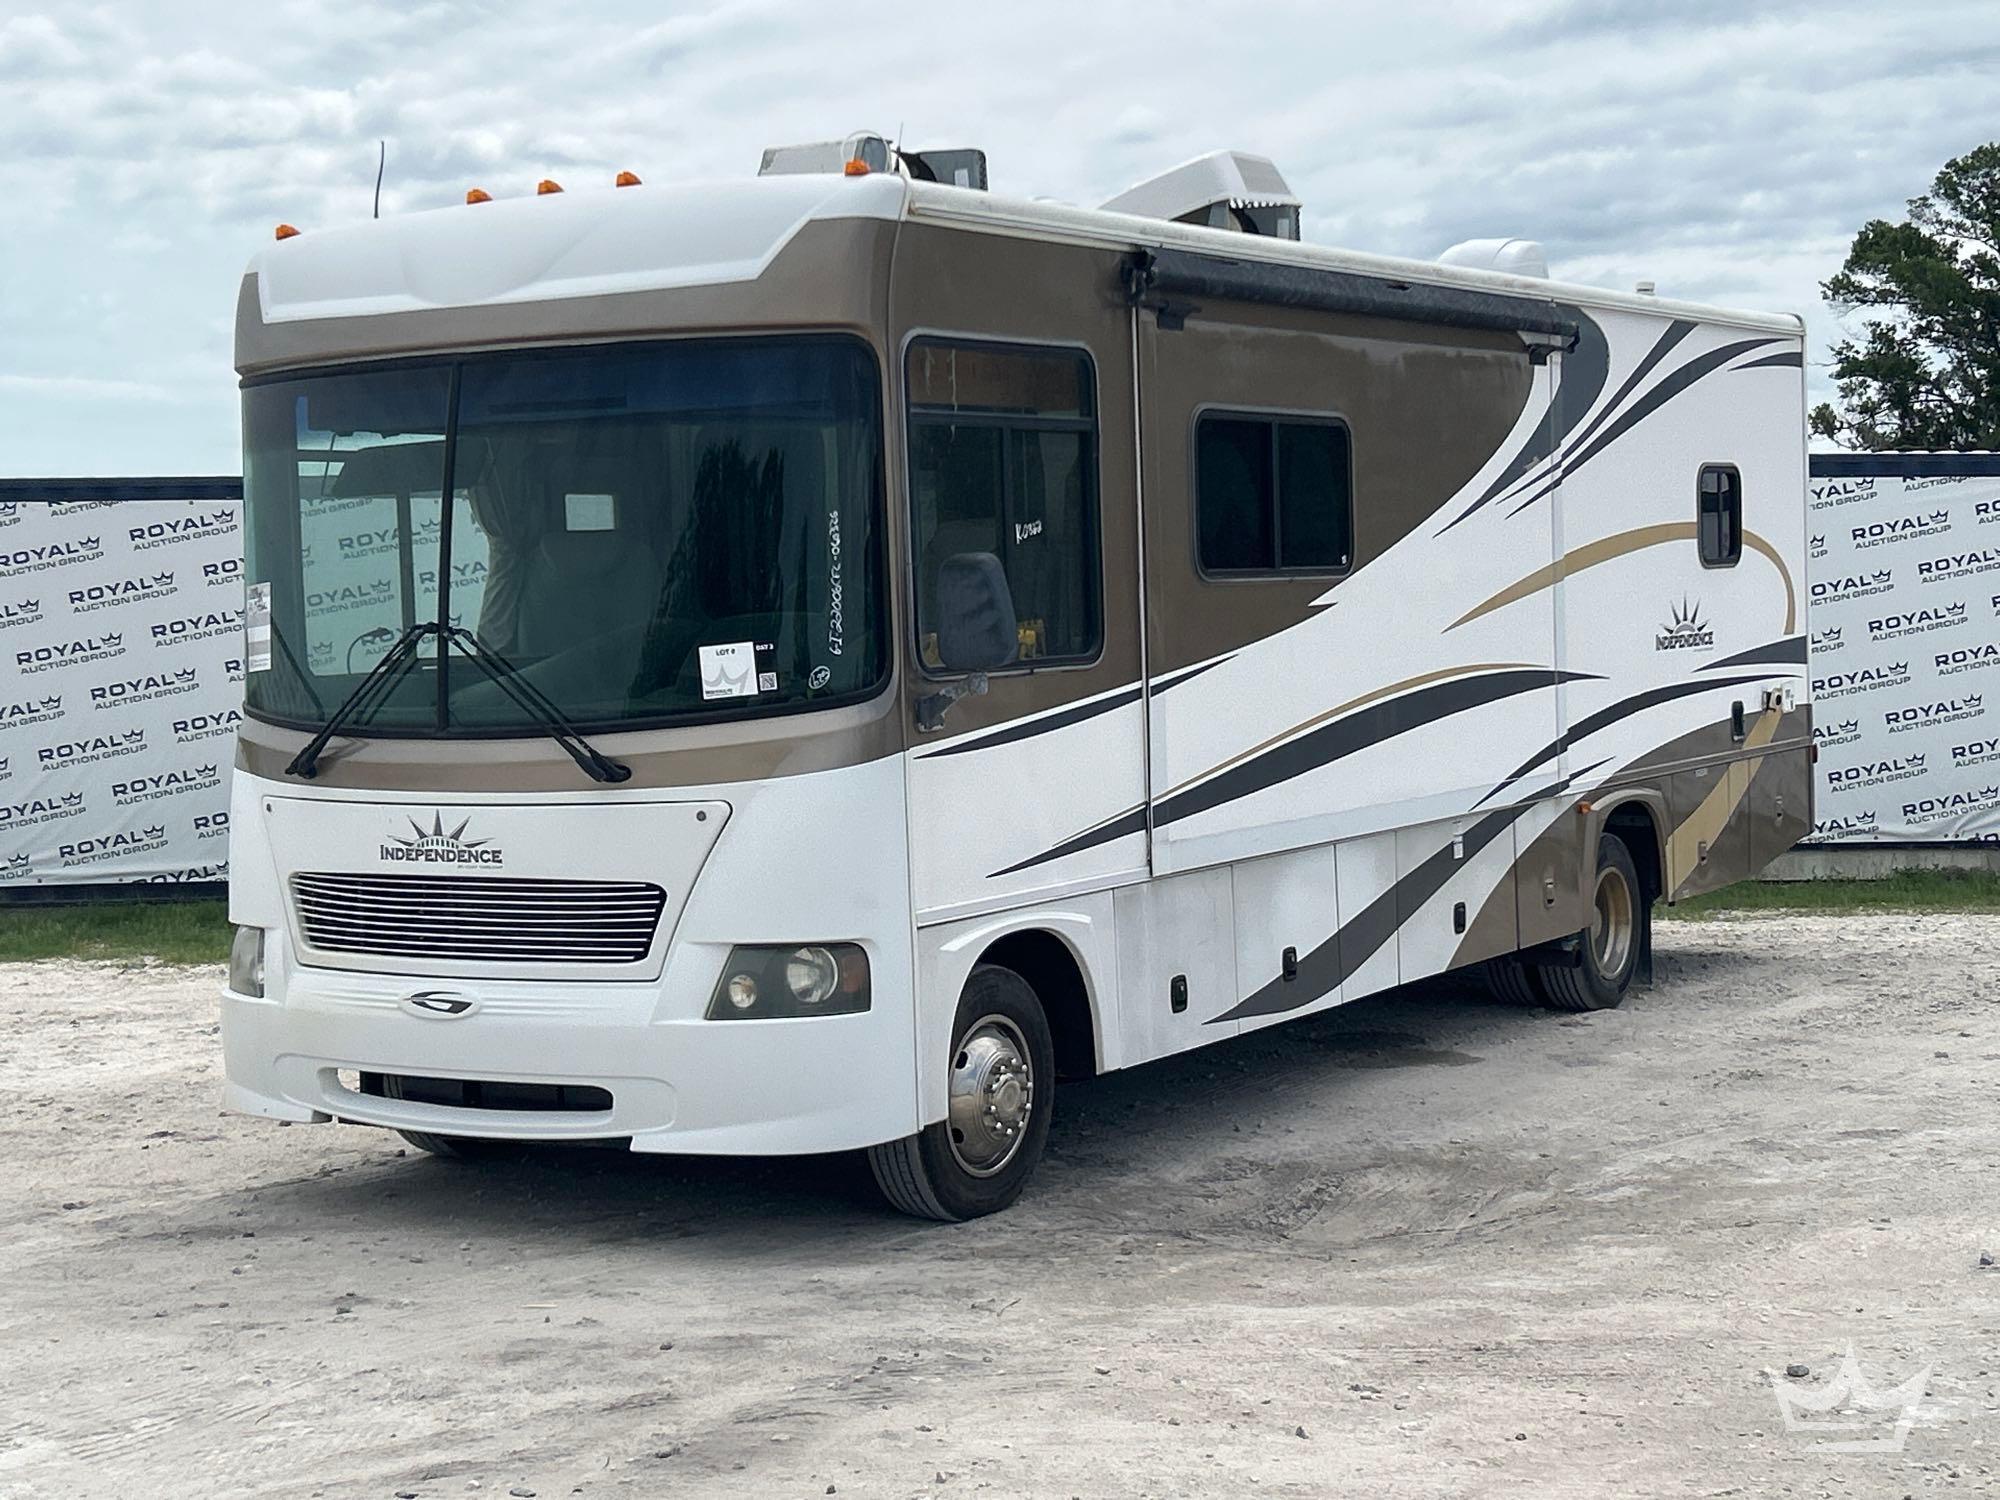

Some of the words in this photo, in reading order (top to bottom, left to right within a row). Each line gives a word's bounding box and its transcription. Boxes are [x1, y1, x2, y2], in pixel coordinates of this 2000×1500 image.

[1836, 491, 1878, 505] GROUP
[129, 516, 213, 541] ROYAL
[133, 533, 190, 551] AUCTION
[193, 524, 238, 538] GROUP
[1851, 515, 1930, 541] ROYAL
[1855, 533, 1908, 550] AUCTION
[1909, 524, 1952, 538] GROUP
[0, 543, 79, 566] ROYAL
[58, 551, 104, 566] GROUP
[1918, 550, 1995, 575] ROYAL
[1811, 576, 1872, 596] OYAL
[1921, 568, 1974, 584] AUCTION
[69, 578, 153, 604] ROYAL
[73, 597, 130, 614] AUCTION
[133, 587, 178, 601] GROUP
[307, 586, 371, 607] OYAL
[1852, 584, 1895, 598] GROUP
[151, 612, 235, 638] ROYAL
[1868, 608, 1946, 633] ROYAL
[1872, 626, 1925, 642] AUCTION
[1926, 616, 1969, 631] GROUP
[155, 630, 212, 648] AUCTION
[17, 639, 101, 665] ROYAL
[21, 658, 78, 675] AUCTION
[80, 648, 126, 662] GROUP
[1812, 667, 1889, 692] ROYAL
[1938, 660, 1991, 676] AUCTION
[90, 674, 175, 700] ROYAL
[94, 693, 152, 710] AUCTION
[155, 683, 200, 697] GROUP
[1814, 685, 1867, 701] AUCTION
[1868, 676, 1911, 690] GROUP
[20, 710, 65, 725] GROUP
[173, 709, 243, 734] ROYA
[1885, 699, 1963, 725] ROYAL
[1888, 718, 1942, 734] AUCTION
[1943, 708, 1985, 722] GROUP
[177, 726, 234, 744] AUCTION
[1820, 733, 1862, 748] GROUP
[38, 735, 123, 762] ROYAL
[42, 754, 100, 772] AUCTION
[102, 743, 148, 759] GROUP
[112, 770, 196, 797] ROYAL
[1828, 759, 1906, 784] ROYAL
[1831, 777, 1884, 793] AUCTION
[1886, 768, 1928, 782] GROUP
[116, 789, 174, 807] AUCTION
[176, 779, 221, 794] GROUP
[1902, 792, 1980, 816] ROYAL
[41, 807, 87, 822] GROUP
[1905, 810, 1958, 825] AUCTION
[59, 831, 144, 858] ROYAL
[1837, 826, 1879, 839] GROUP
[63, 850, 121, 868] AUCTION
[123, 840, 169, 855] GROUP
[380, 845, 503, 863] INDEPENDENCE
